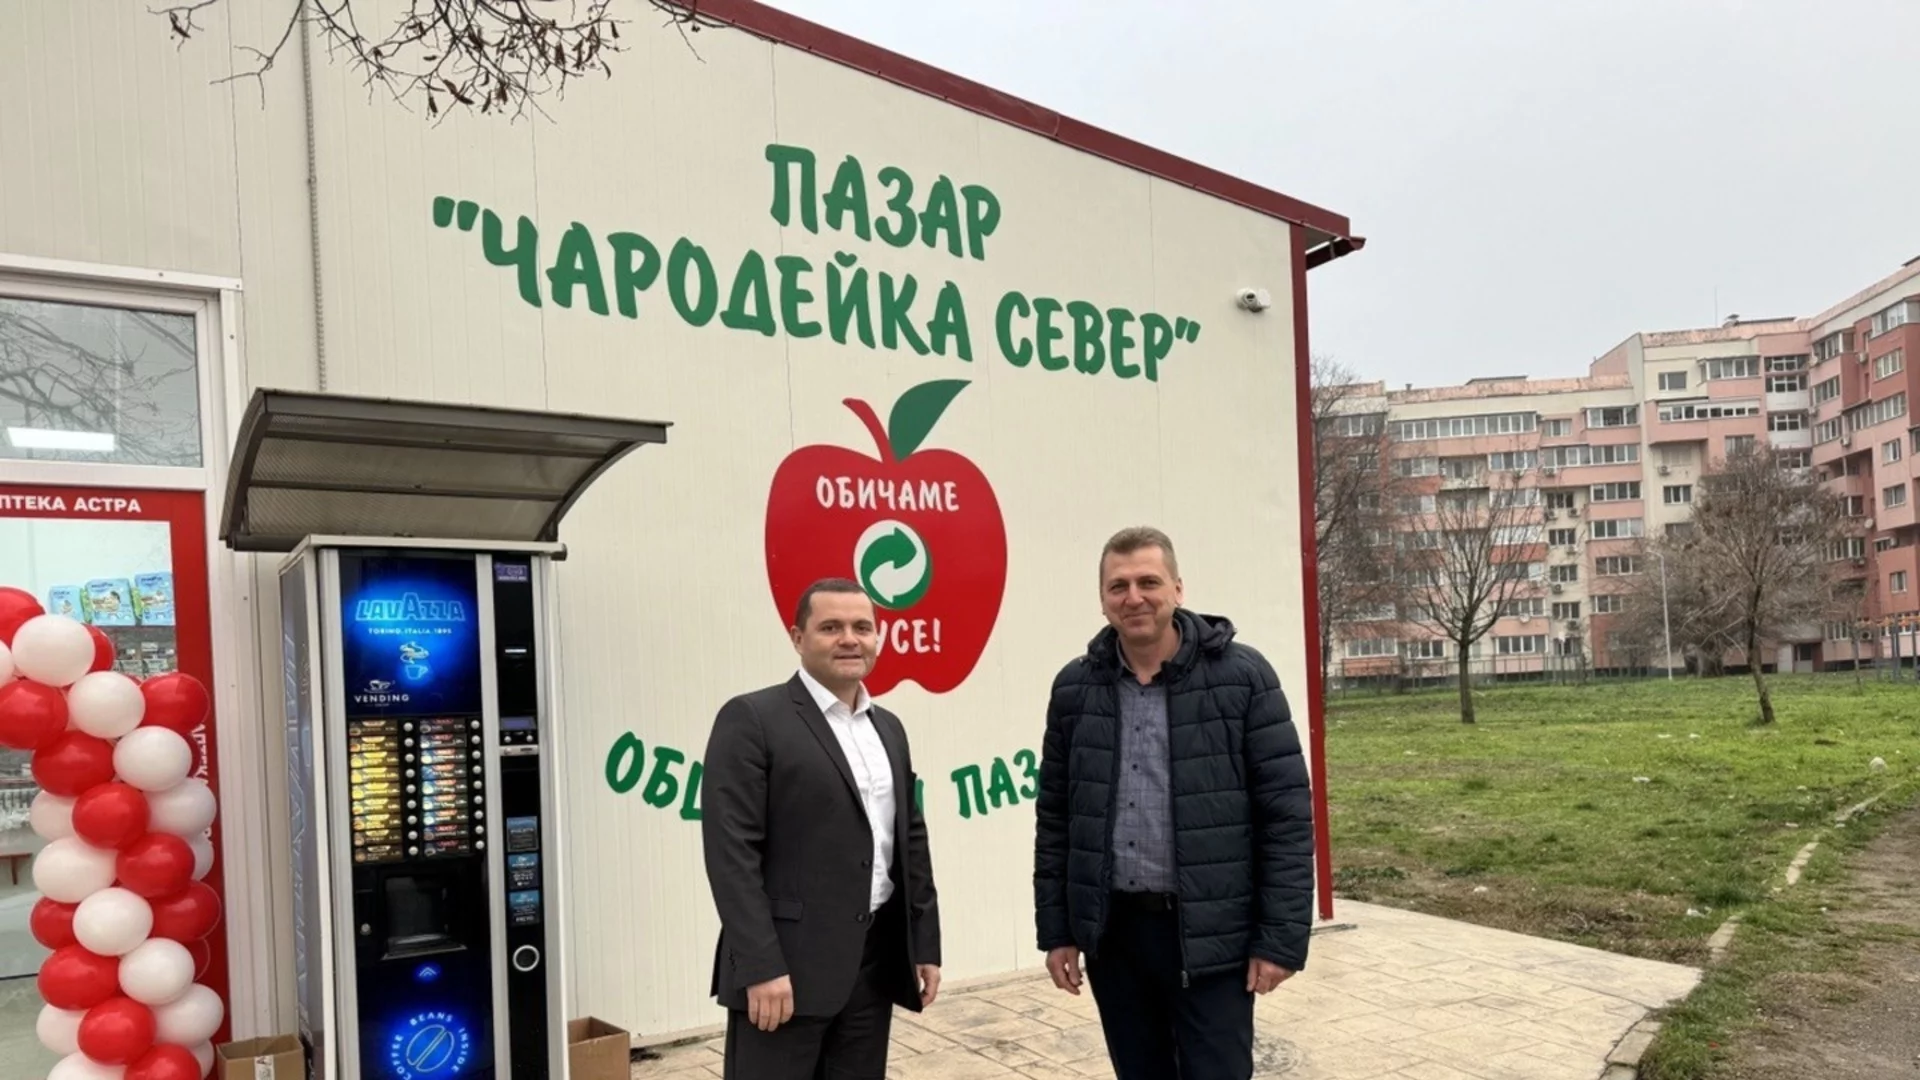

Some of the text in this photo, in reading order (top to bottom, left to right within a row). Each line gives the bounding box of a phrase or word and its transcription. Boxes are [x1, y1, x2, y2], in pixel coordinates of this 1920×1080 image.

[766, 144, 1000, 260] ПАЗАР
[434, 197, 1200, 381] "ЧАРОДЕЙКА СЕВЕР"
[0, 495, 142, 513] ПТЕКА АСТРА
[816, 475, 960, 512] ОБИЧАМЕ
[356, 592, 465, 621] LAVAZZA
[876, 617, 941, 657] УСЕ!
[354, 694, 409, 703] VENDING
[410, 1012, 453, 1026] BEANS
[452, 1028, 468, 1072] INSIDE
